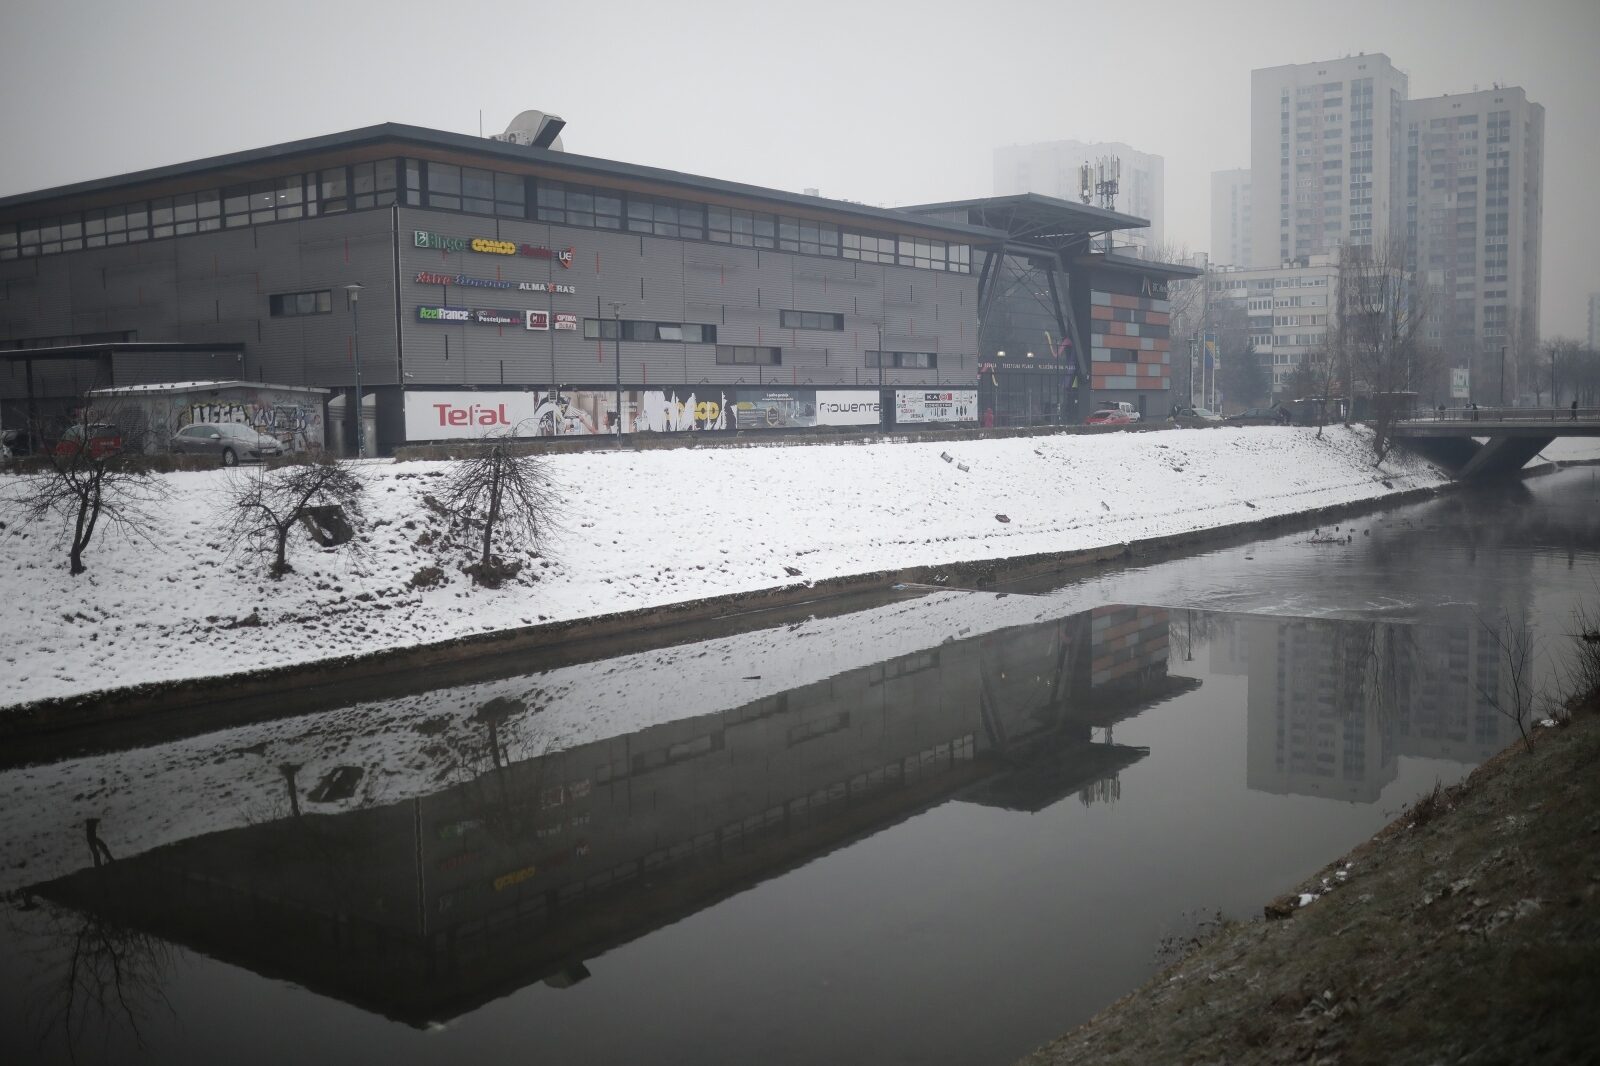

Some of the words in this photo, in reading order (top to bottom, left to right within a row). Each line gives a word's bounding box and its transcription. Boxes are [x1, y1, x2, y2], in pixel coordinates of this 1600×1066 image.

[471, 239, 516, 255] COMOD
[519, 282, 546, 291] ALMA
[556, 285, 576, 294] RAS
[557, 314, 577, 322] OPTIKA
[432, 403, 511, 427] Tefal
